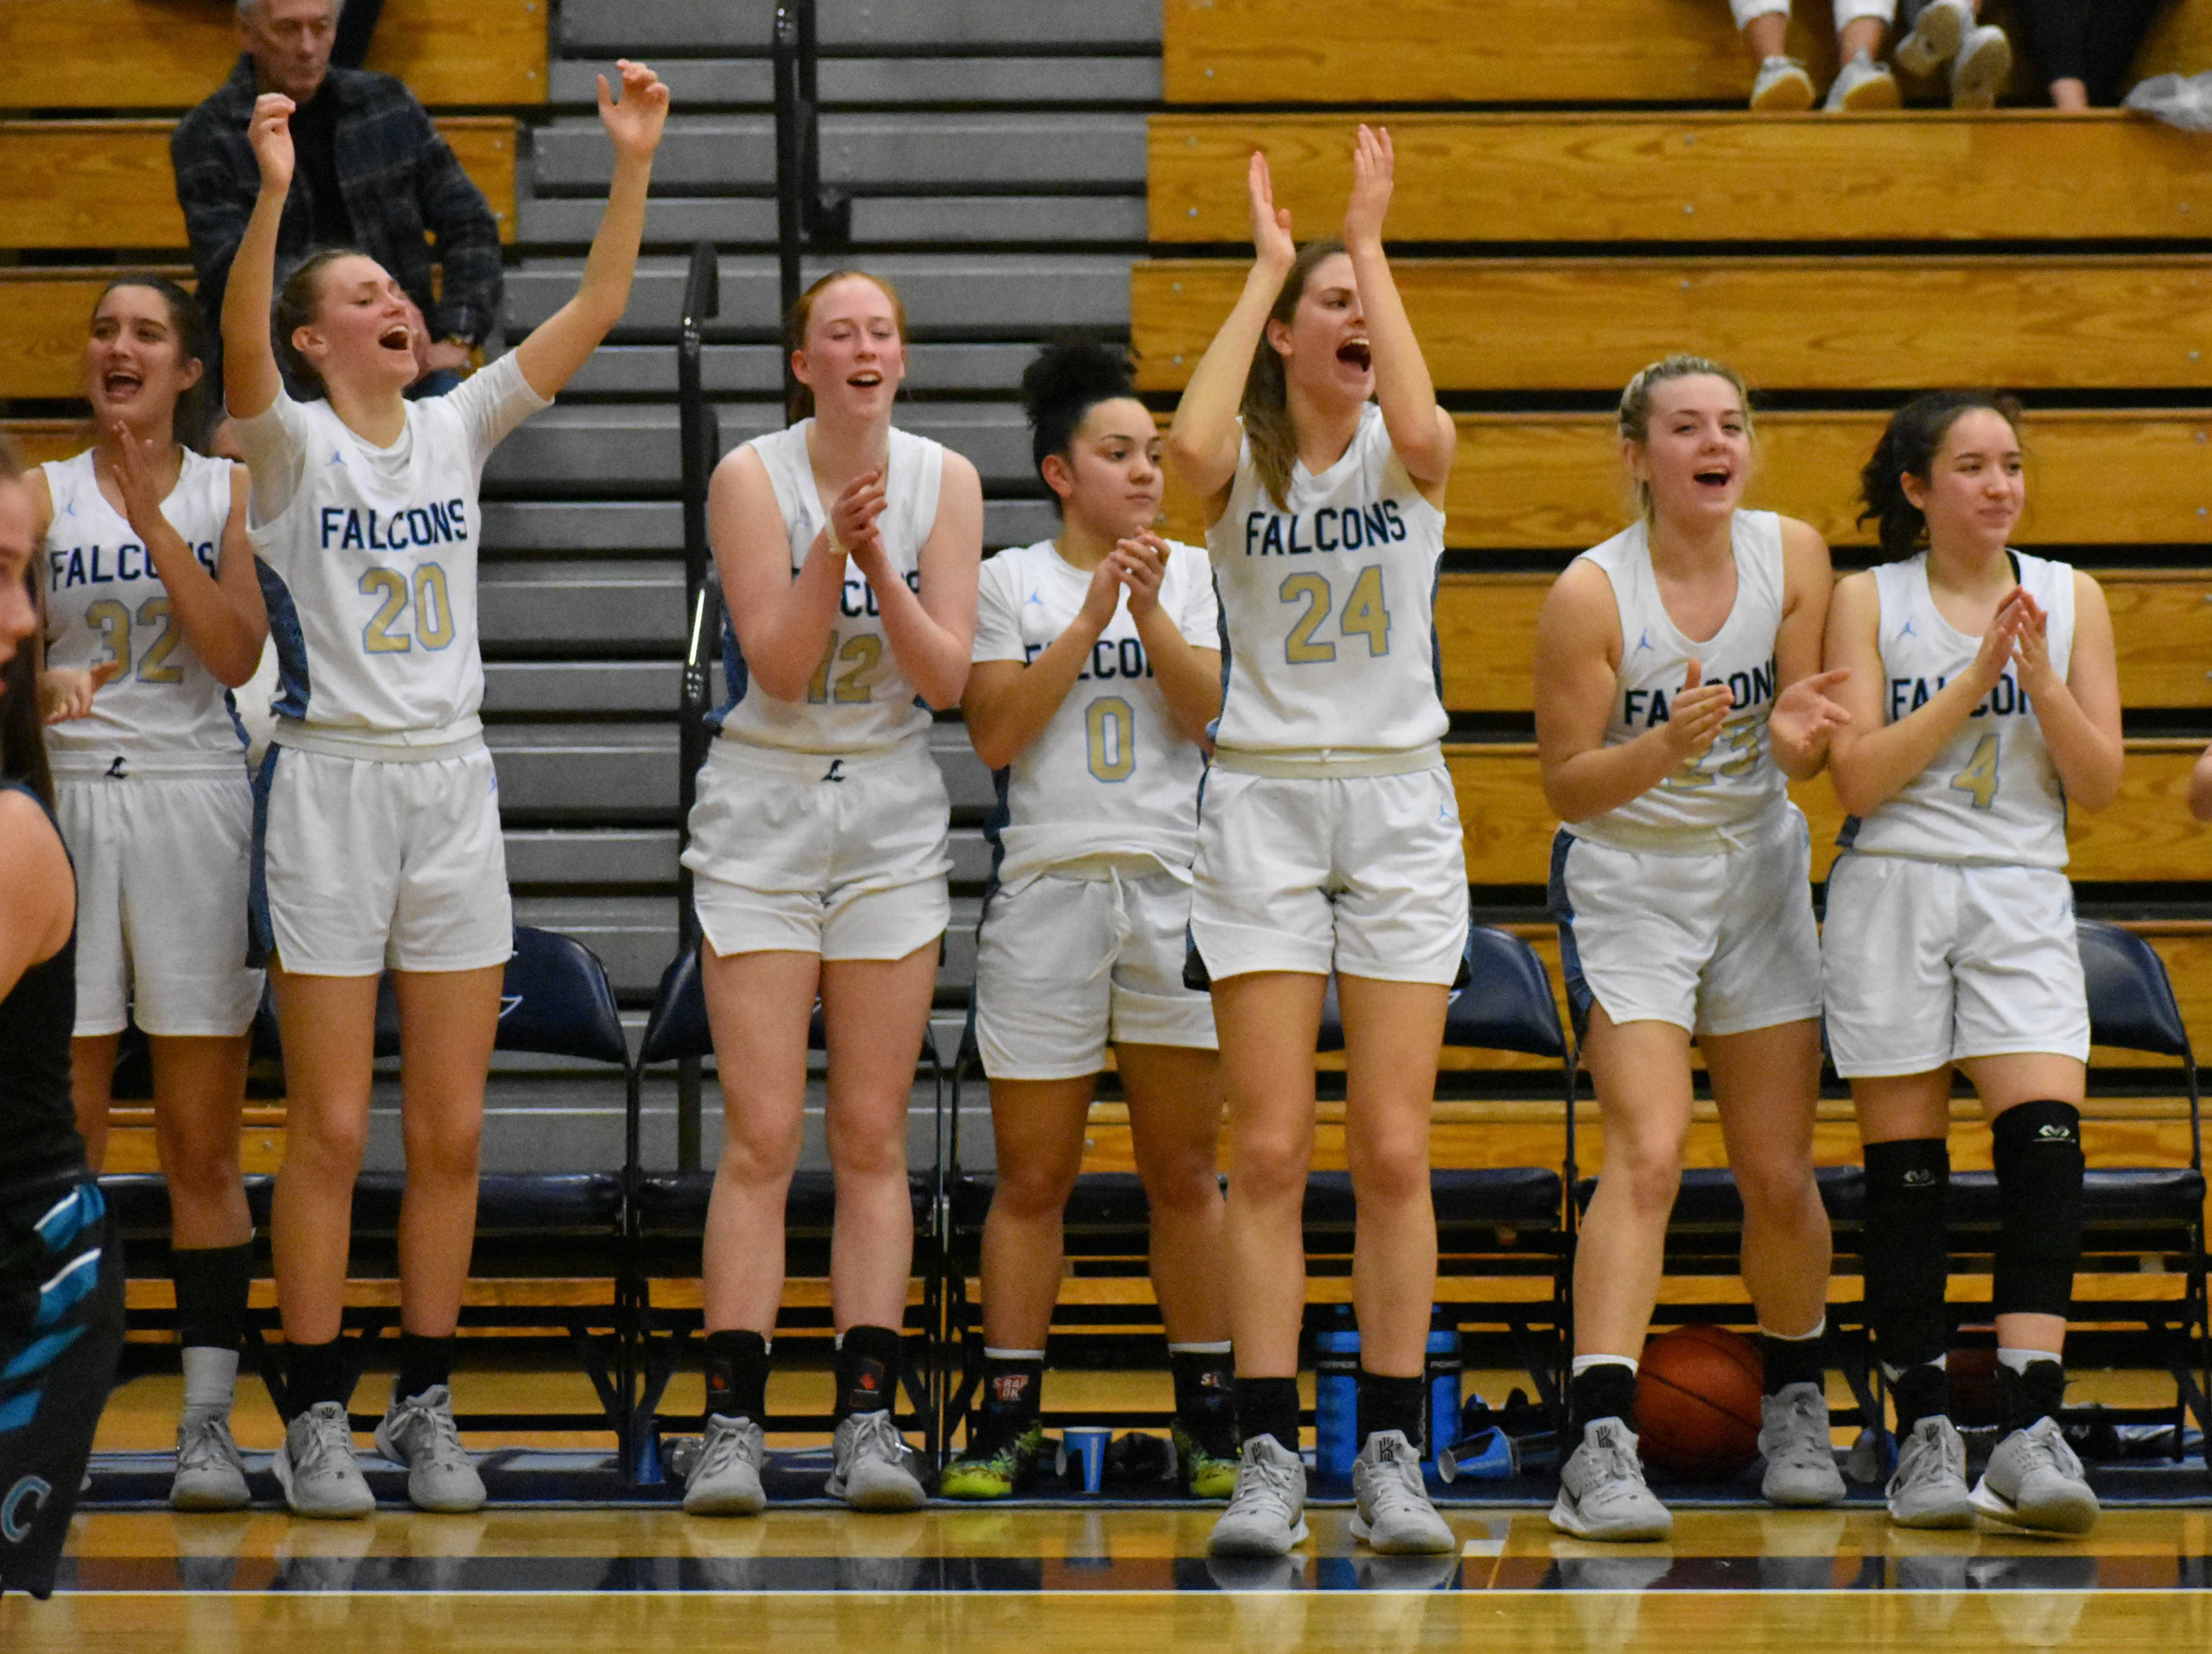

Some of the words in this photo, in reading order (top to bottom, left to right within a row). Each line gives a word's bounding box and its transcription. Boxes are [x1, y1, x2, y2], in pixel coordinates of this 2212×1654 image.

[321, 498, 468, 550] FALCONS
[1246, 499, 1407, 556] FALCONS
[85, 596, 184, 684] 32
[358, 561, 456, 654] 20
[1279, 564, 1391, 665] 24
[1085, 696, 1136, 783] 0
[1950, 732, 2001, 809] 4
[1, 1475, 52, 1543] C
